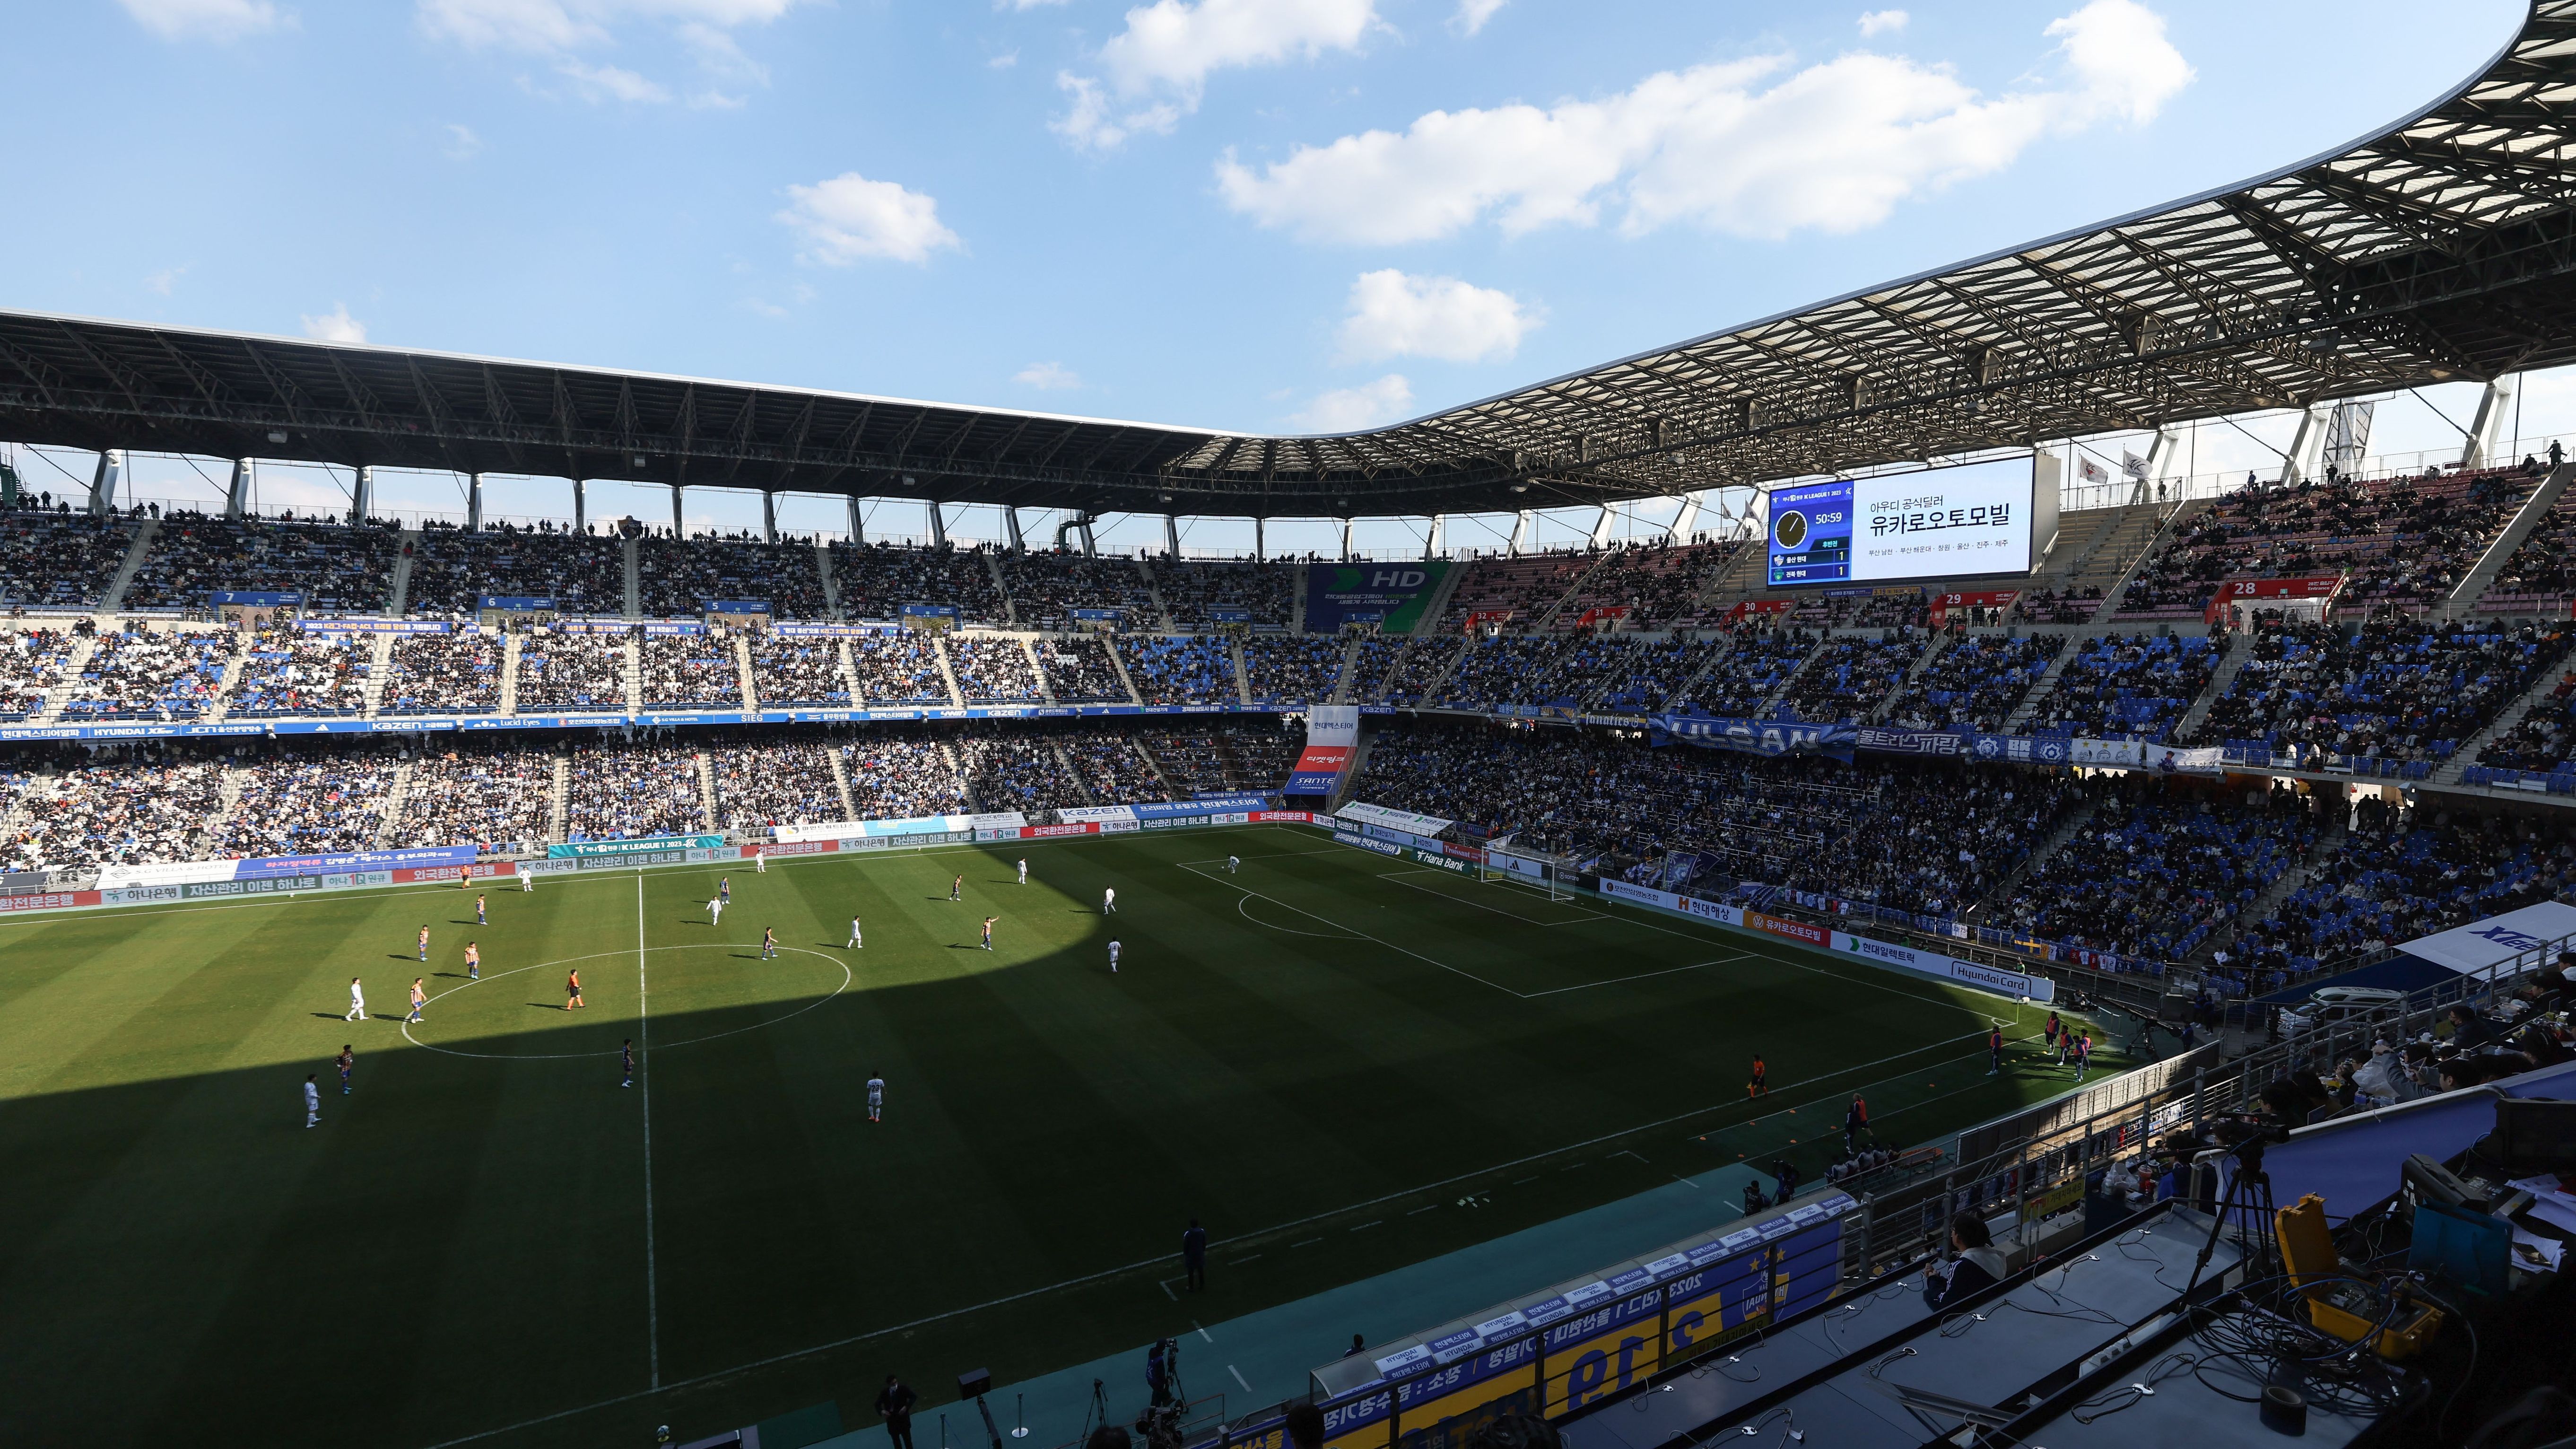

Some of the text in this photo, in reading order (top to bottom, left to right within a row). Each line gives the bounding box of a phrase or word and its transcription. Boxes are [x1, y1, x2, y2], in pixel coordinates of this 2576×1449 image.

[1871, 495, 1943, 513] 아우디 공식딜러
[1816, 512, 1842, 524] 50:59
[1870, 503, 2010, 536] 유카로오토모빌
[1914, 545, 1931, 553] 해운대
[1977, 541, 1989, 549] 진주
[1839, 551, 1843, 560] 1
[1839, 567, 1843, 575] 1
[1372, 571, 1426, 587] HD
[2235, 582, 2255, 594] 28
[226, 593, 234, 602] 7
[488, 598, 496, 606] 6
[1946, 594, 1961, 604] 29
[1745, 602, 1756, 611] 30
[1314, 722, 1353, 730] 현대엑스티어
[1, 729, 80, 738] 현대엑스티어알파
[1670, 721, 1821, 751] ULSAN
[1200, 798, 1259, 809] 현대엑스티어
[1144, 816, 1208, 828] 자산관리 이젠 하나로
[1260, 812, 1307, 822] 외국환전문은행
[1320, 816, 1334, 828] 하나은행
[1034, 824, 1087, 836] 외국환전문은행
[1113, 819, 1138, 830] 하나은행
[1336, 820, 1353, 831] 자산관리
[893, 832, 972, 846] 자산관리 이젠 하나로
[1375, 828, 1395, 839] 현대건설기계
[854, 836, 885, 847] 하나은행
[1362, 836, 1396, 854] 현대엑스티어
[1418, 838, 1433, 848] HD현대
[758, 842, 822, 855] 외국환전문은행
[1444, 845, 1471, 858] Troissant
[266, 859, 322, 868] 하지정맥류
[325, 857, 357, 865] 김병준
[535, 860, 573, 871] 하나은행
[583, 852, 681, 868] 자산관리 이젠 하나로
[1424, 852, 1465, 871] Hana Bank
[414, 864, 495, 880] 외국환전은행
[190, 876, 316, 897] 자산관리 이젠 하나로
[127, 886, 176, 900] 하나은행
[1614, 886, 1658, 901] 포천인삼영농조합
[1693, 900, 1730, 920] 현대해상
[1767, 919, 1821, 941] 유카로오토모빌
[1863, 943, 1915, 963] 현대일렉트릭
[1958, 967, 2024, 990] Hyundai Card
[871, 1085, 880, 1093] 23
[1726, 1230, 1749, 1241] HYUNDAI
[1653, 1256, 1677, 1267] HYUNDAI
[1700, 1252, 1723, 1263] HYUNDAI
[1612, 1270, 1644, 1284] 현대엑스티어
[1572, 1283, 1598, 1296] HYUNDAI
[1622, 1279, 1646, 1292] HYUNDAI
[1528, 1299, 1562, 1315] 현대엑스티어
[1484, 1315, 1513, 1328] HYUNDAI
[1538, 1309, 1566, 1323] HYUNDAI
[1434, 1331, 1472, 1349] 현대엑스티어
[1386, 1349, 1417, 1363] HYUNDAI
[1445, 1343, 1475, 1358] HYUNDAI
